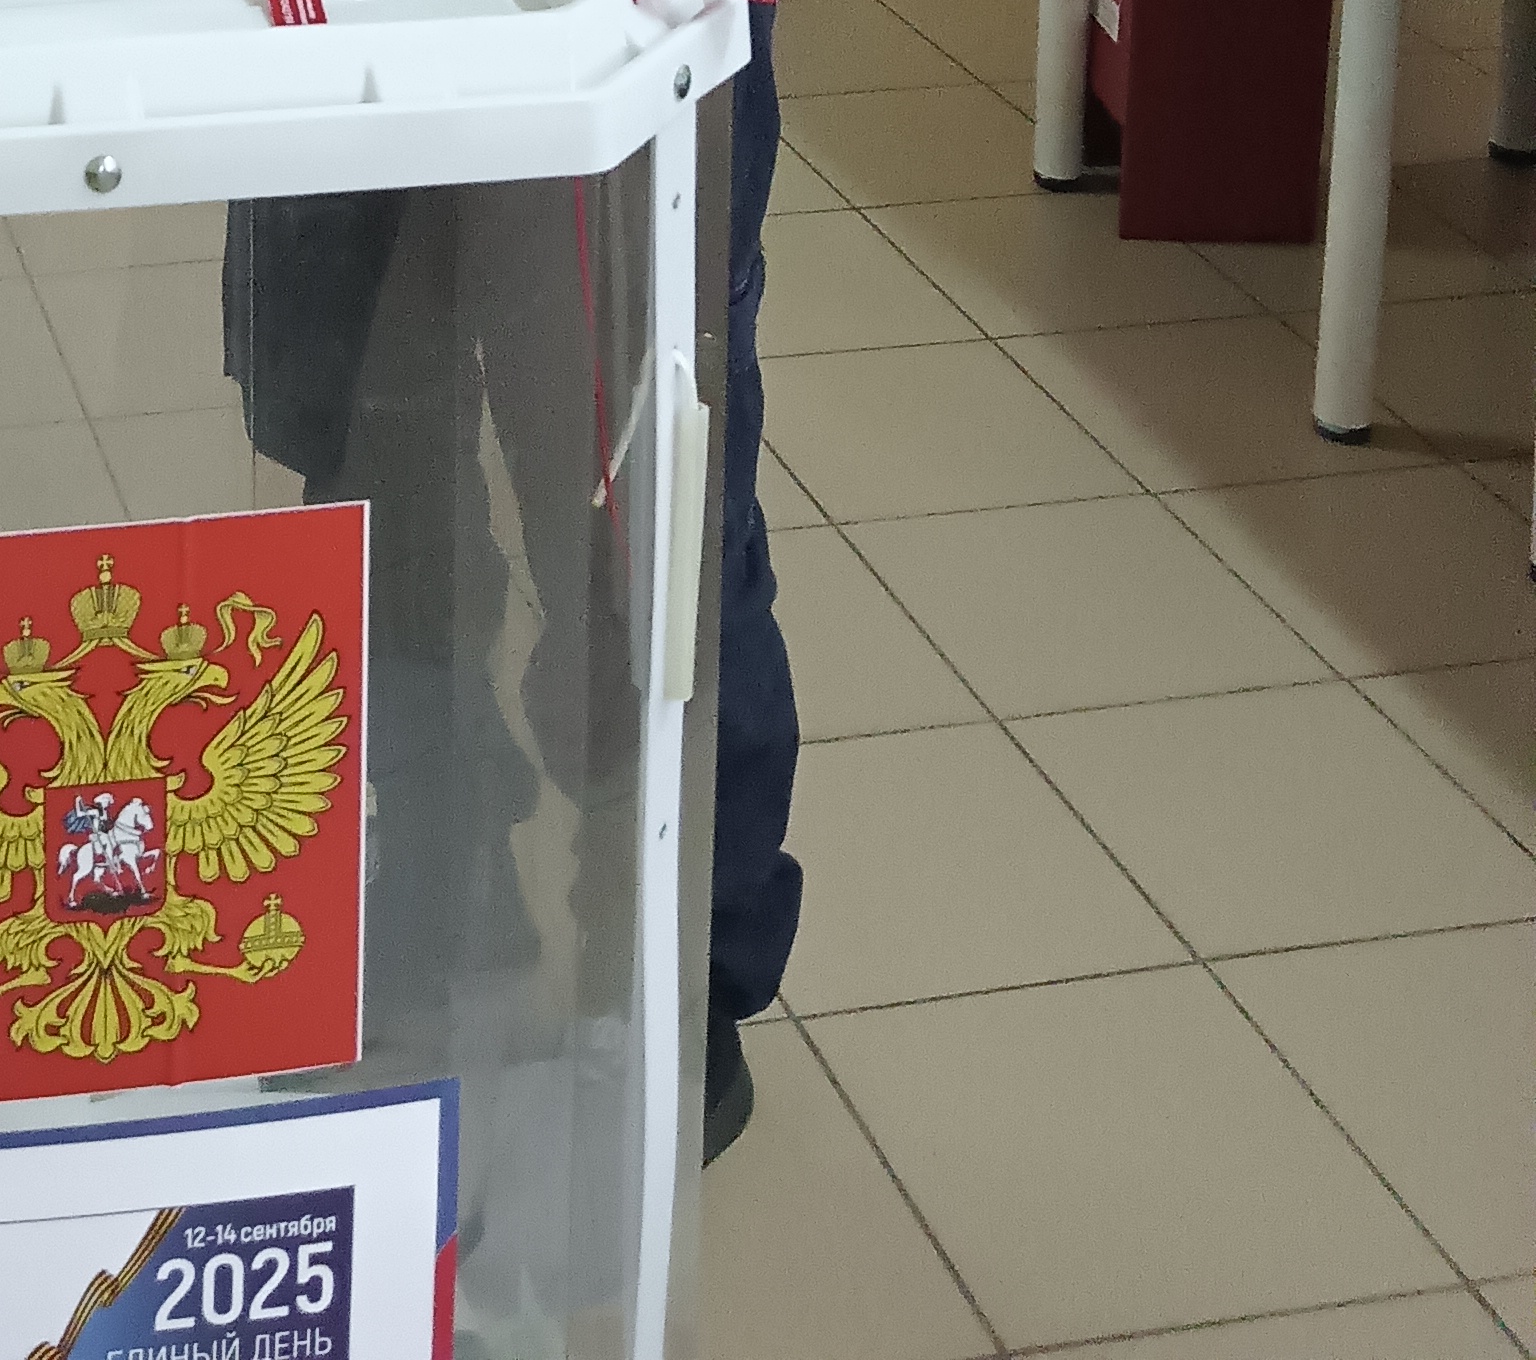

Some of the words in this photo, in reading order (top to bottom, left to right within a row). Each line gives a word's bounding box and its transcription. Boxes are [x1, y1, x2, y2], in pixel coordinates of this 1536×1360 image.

[184, 1223, 237, 1249] 12-14
[240, 1214, 336, 1243] сентября
[154, 1241, 335, 1332] 2025
[253, 1327, 332, 1360] ДЕНЬ
